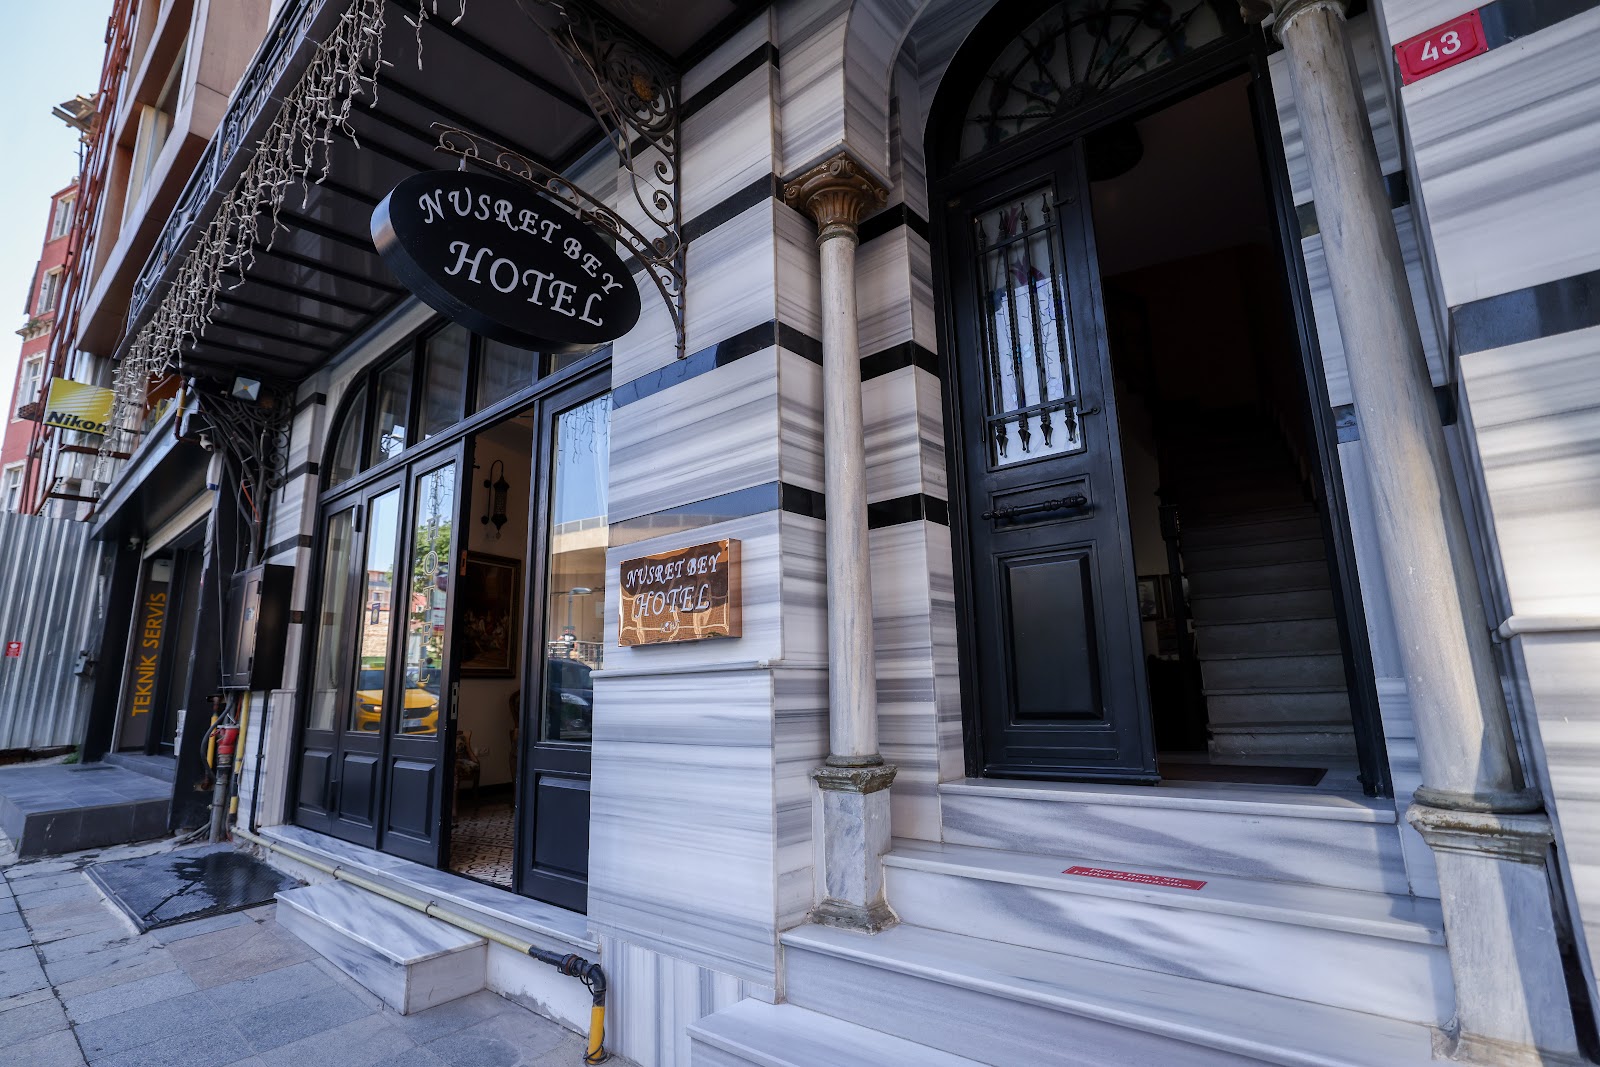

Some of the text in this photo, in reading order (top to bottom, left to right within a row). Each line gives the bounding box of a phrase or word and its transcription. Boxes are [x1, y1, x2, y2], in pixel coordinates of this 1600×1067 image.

[1421, 31, 1461, 61] 43
[418, 187, 624, 295] NUSRET BEY
[444, 240, 603, 327] HOTEL
[47, 411, 107, 433] Nikon
[417, 515, 442, 684] HOTEL
[626, 552, 721, 588] NUSRET BEY
[635, 583, 710, 619] HOTEL
[131, 592, 167, 717] TEKNİK SERVİS
